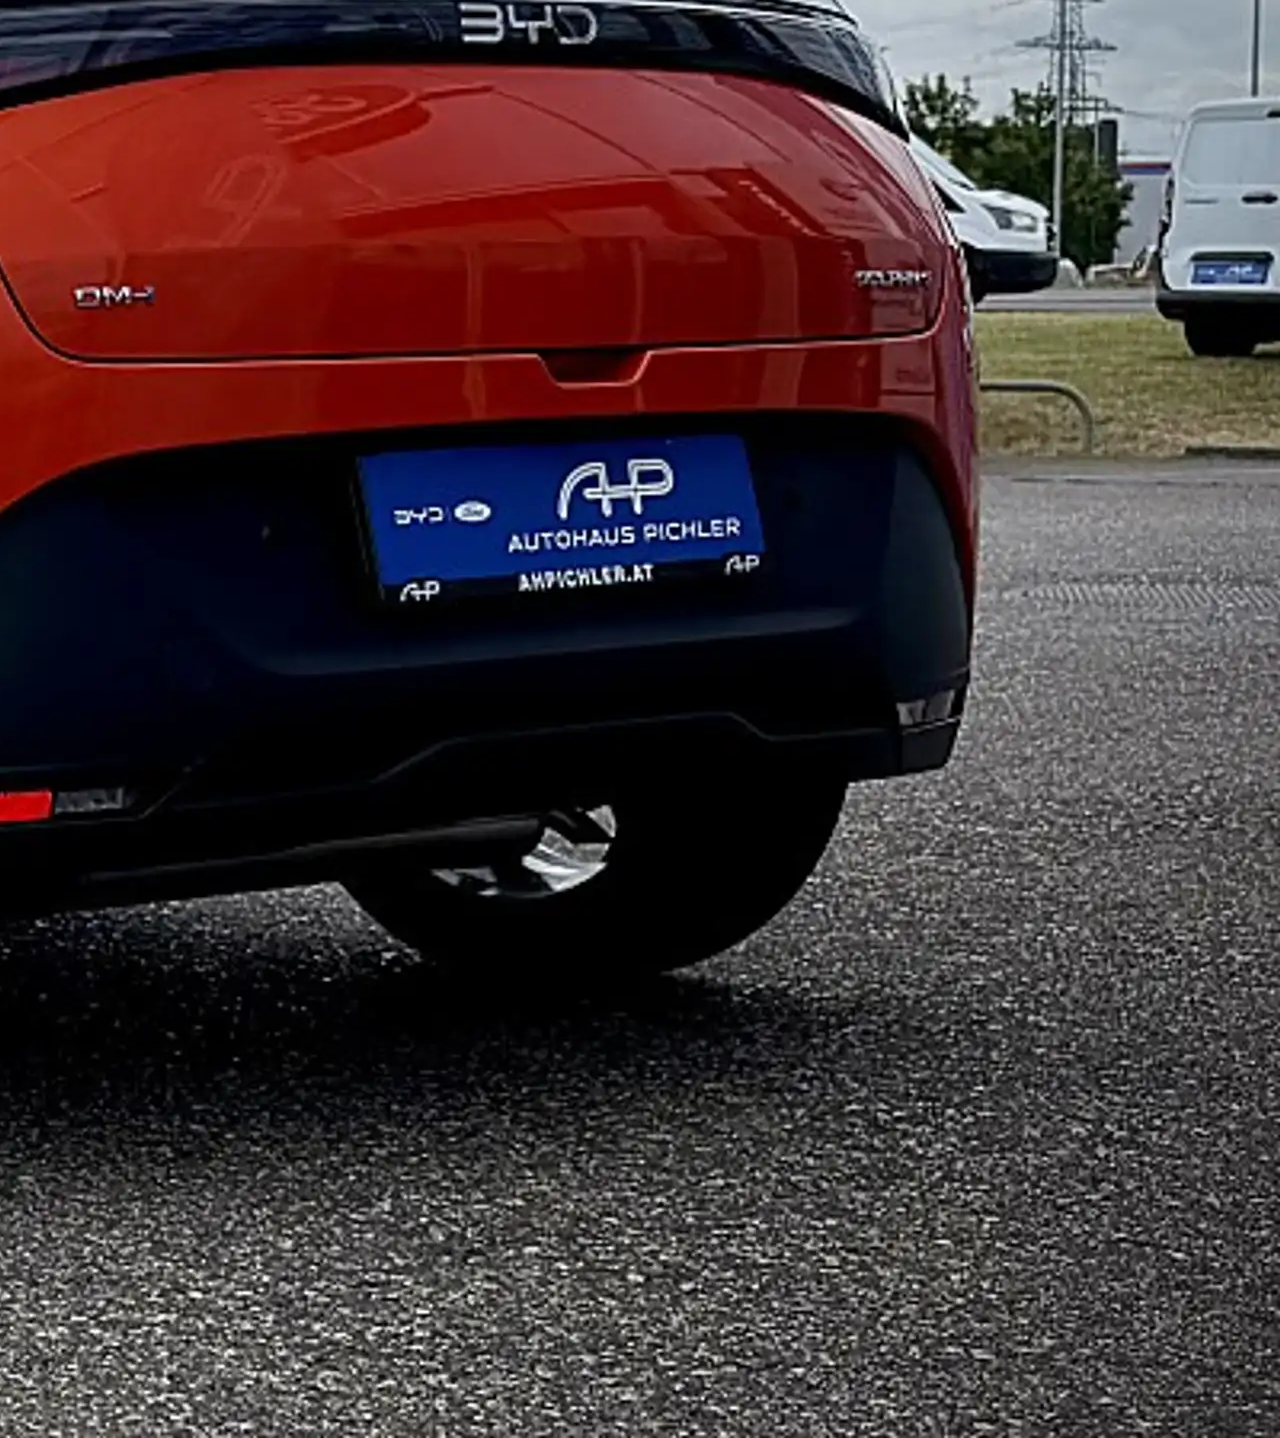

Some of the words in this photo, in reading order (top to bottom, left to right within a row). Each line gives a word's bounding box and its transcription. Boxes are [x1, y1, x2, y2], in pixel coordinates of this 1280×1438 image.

[458, 2, 598, 45] BYD
[507, 524, 636, 554] AUTOHAUS
[642, 515, 741, 544] PICHLER
